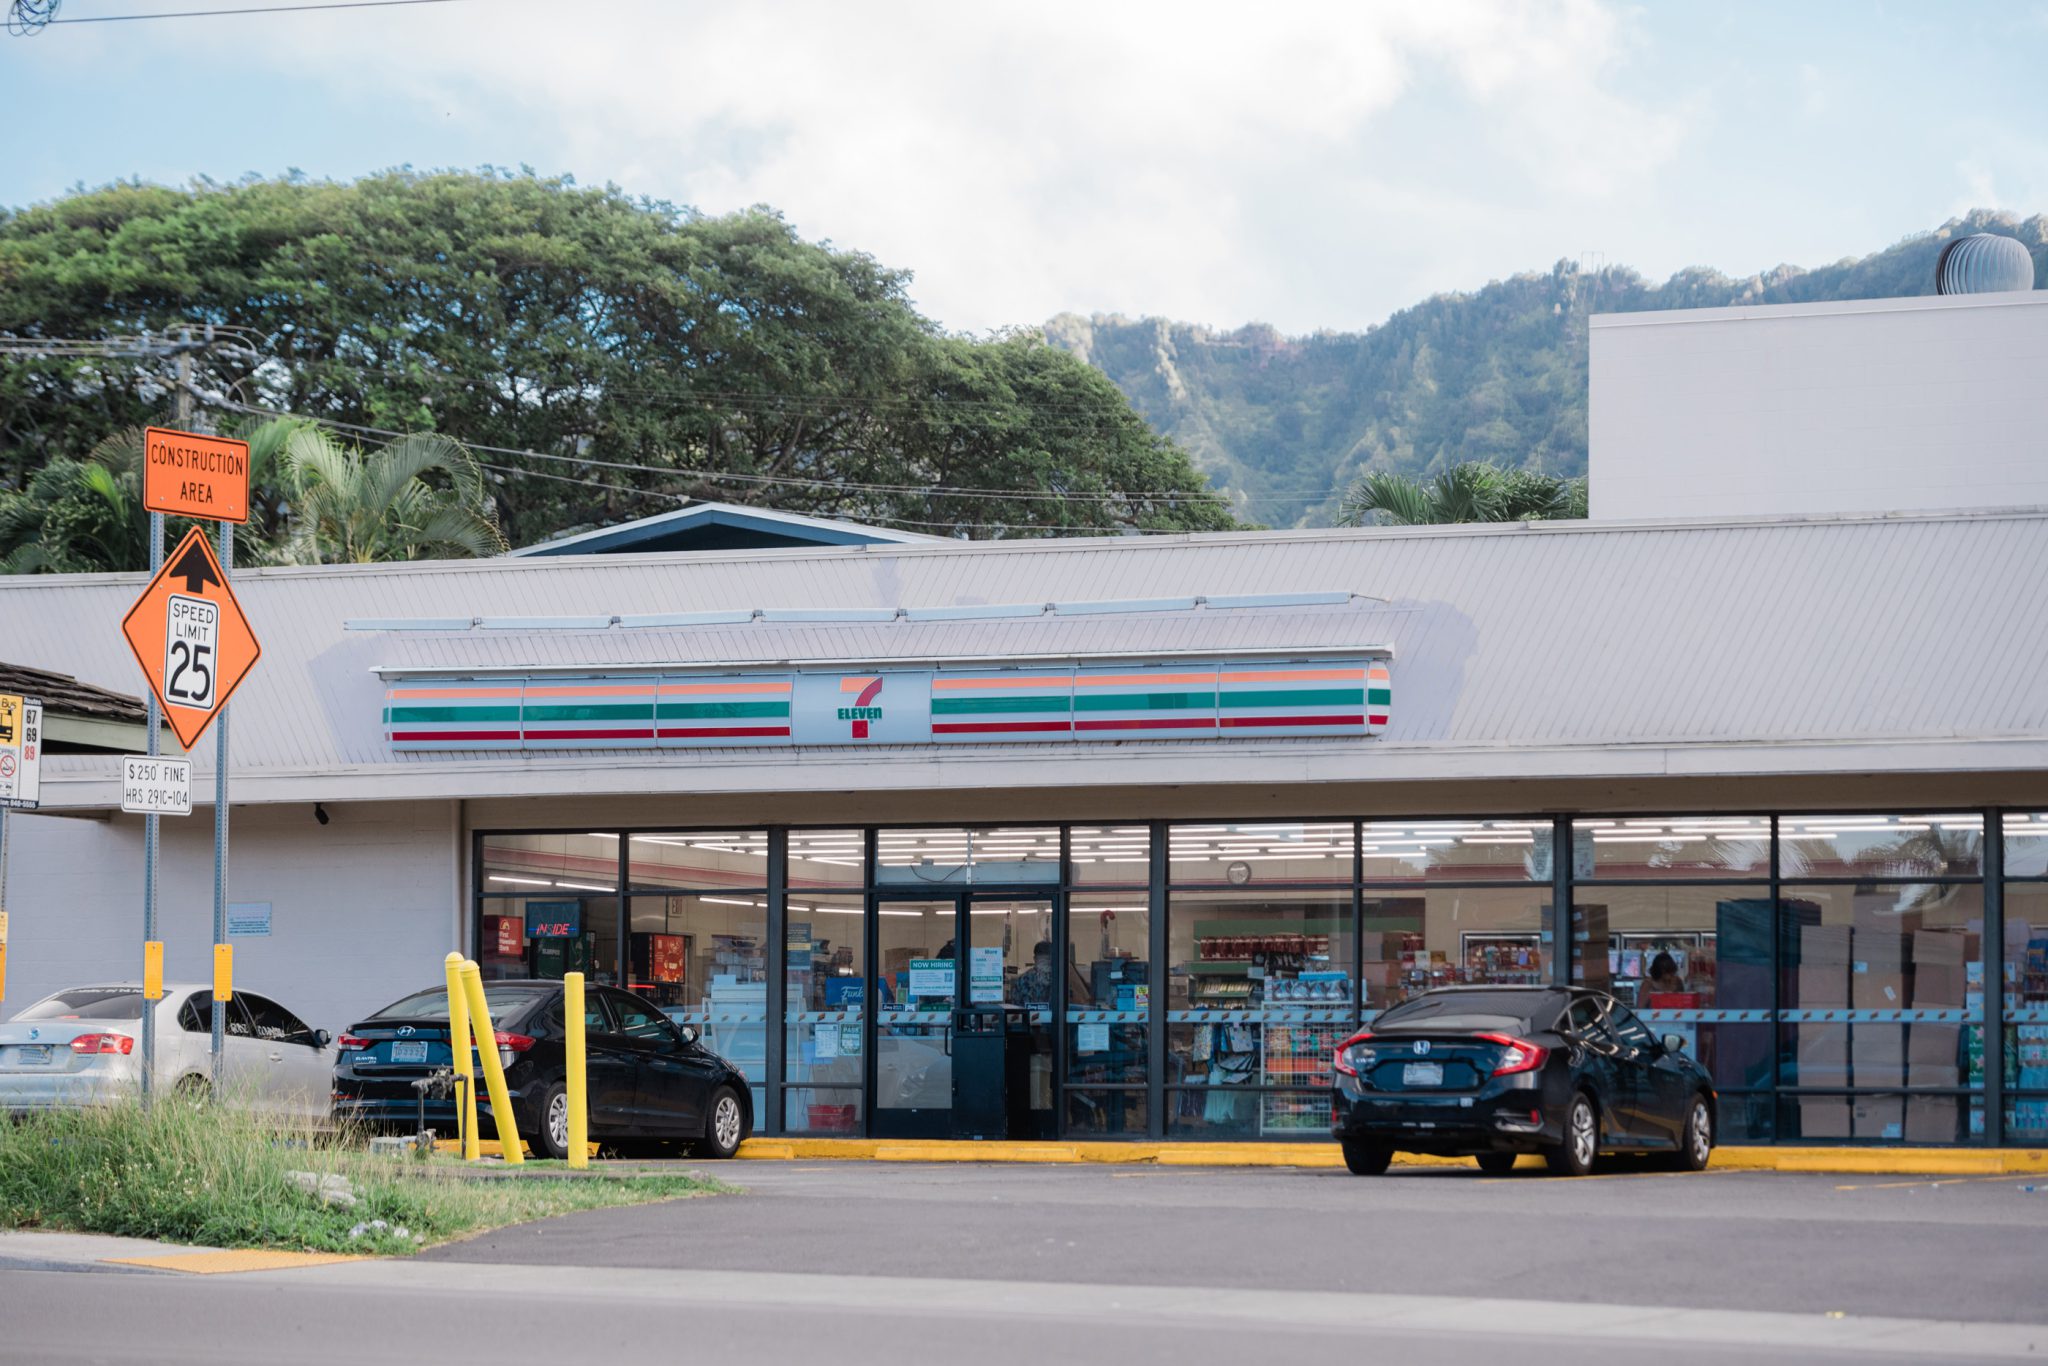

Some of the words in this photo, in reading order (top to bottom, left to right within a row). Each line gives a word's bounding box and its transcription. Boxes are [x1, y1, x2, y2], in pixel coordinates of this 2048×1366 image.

[151, 443, 243, 476] CONSTRUCTION
[180, 481, 213, 504] AREA
[173, 603, 214, 624] SPEED
[176, 622, 209, 642] LIMIT
[169, 640, 211, 702] 25
[26, 709, 37, 724] 67
[840, 676, 883, 738] 7
[26, 727, 37, 742] 69
[24, 745, 35, 760] 89
[164, 766, 185, 783] FINE
[125, 788, 143, 804] HRS
[148, 788, 188, 806] 291C-104
[536, 923, 570, 935] INSIDE
